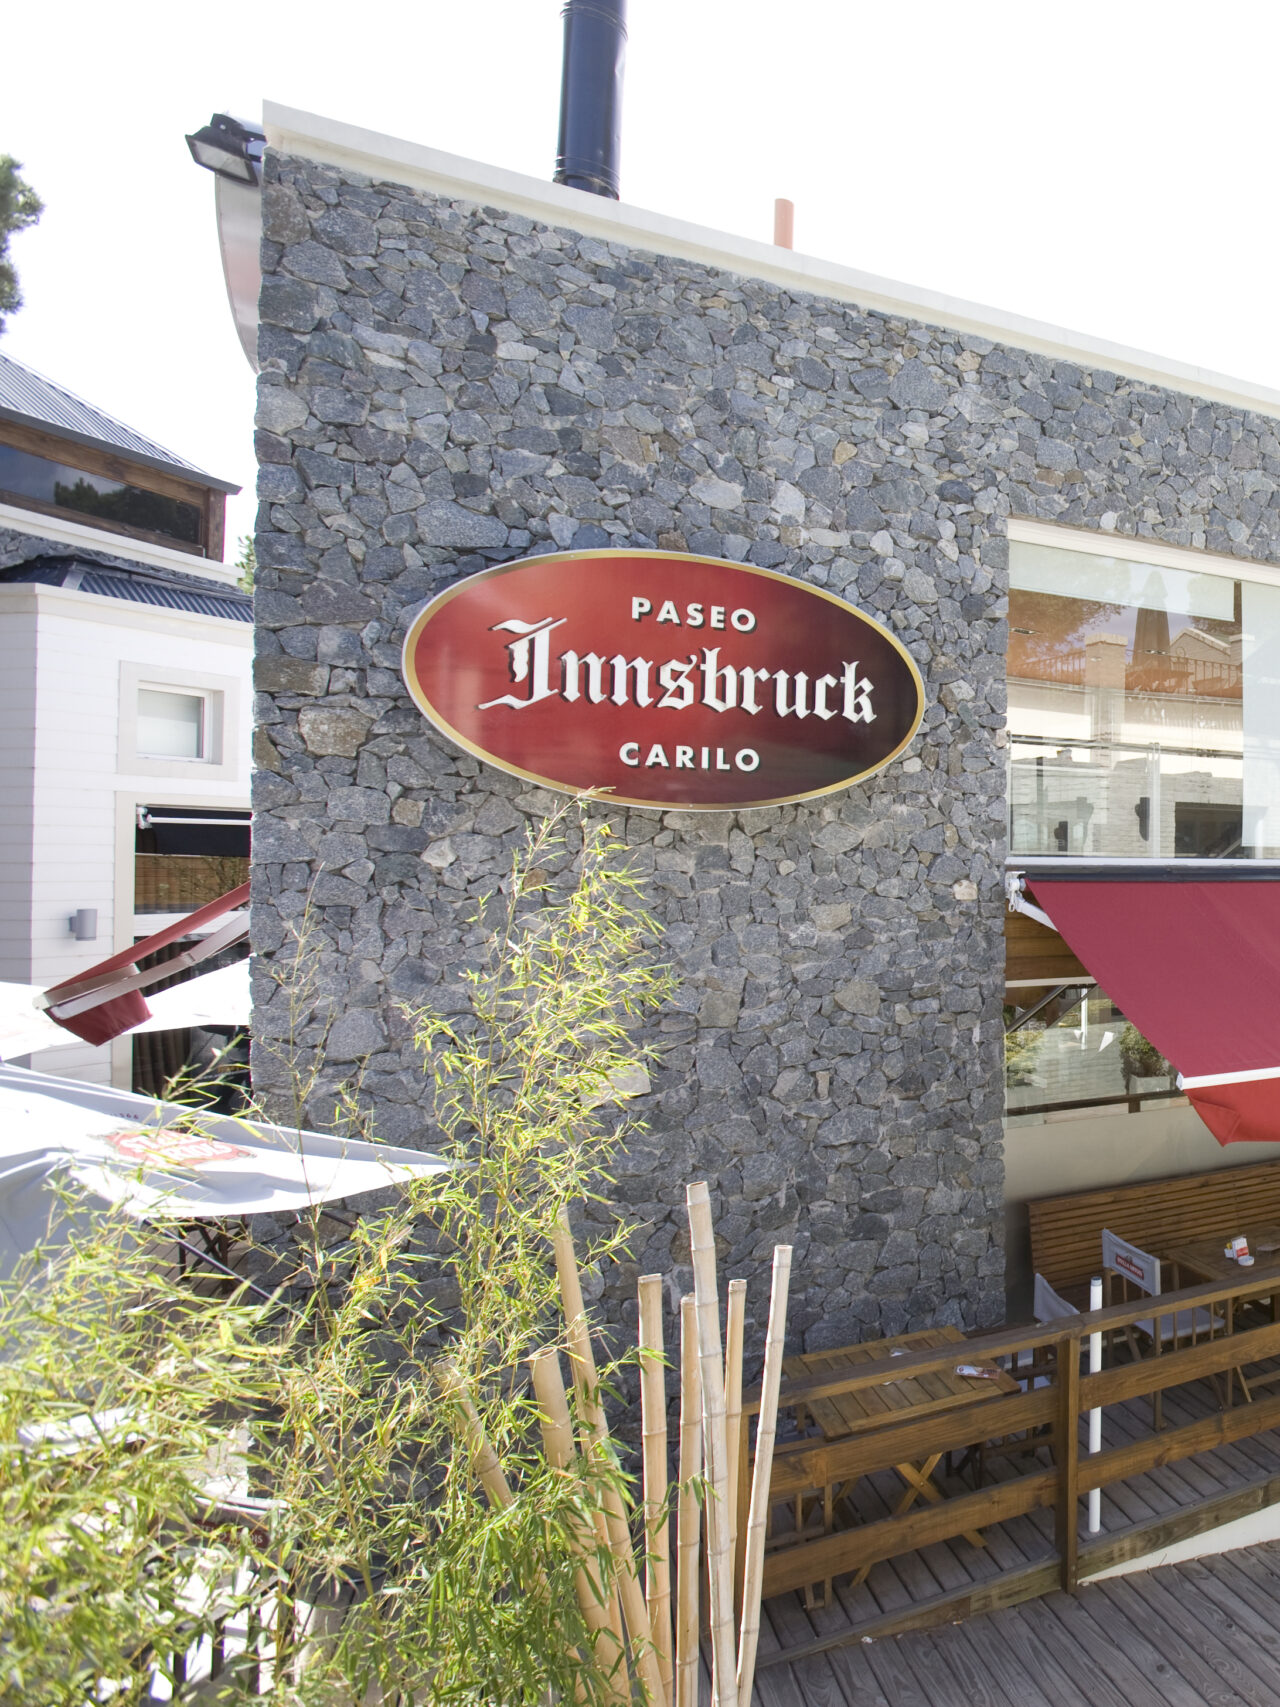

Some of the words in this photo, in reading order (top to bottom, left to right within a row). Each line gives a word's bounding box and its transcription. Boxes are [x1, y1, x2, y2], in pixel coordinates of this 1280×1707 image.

[631, 596, 757, 632] PASEO
[477, 617, 877, 724] Innsbruck
[618, 741, 760, 773] CARILO
